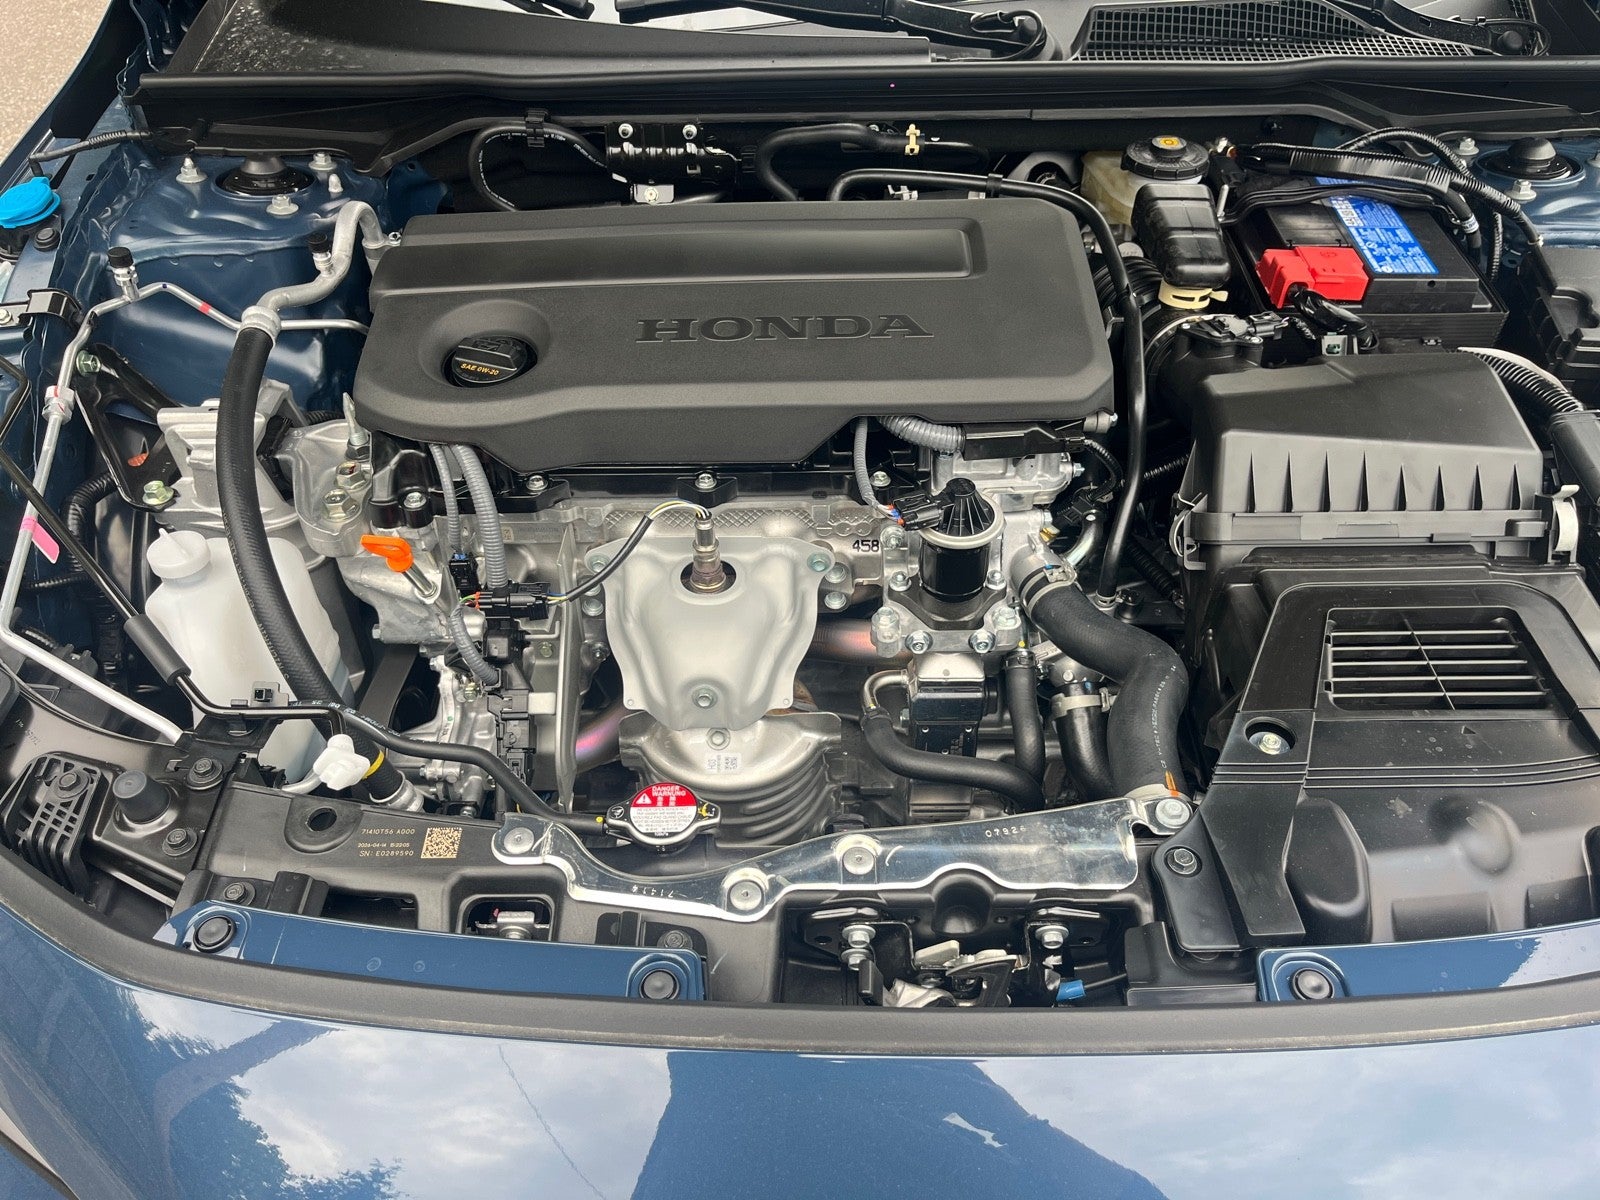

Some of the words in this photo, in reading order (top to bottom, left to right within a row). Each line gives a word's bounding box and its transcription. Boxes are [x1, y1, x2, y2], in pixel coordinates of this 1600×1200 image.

[636, 314, 935, 344] HONDA
[460, 363, 477, 371] SAE
[477, 366, 500, 376] 0W-20
[852, 539, 880, 552] 458
